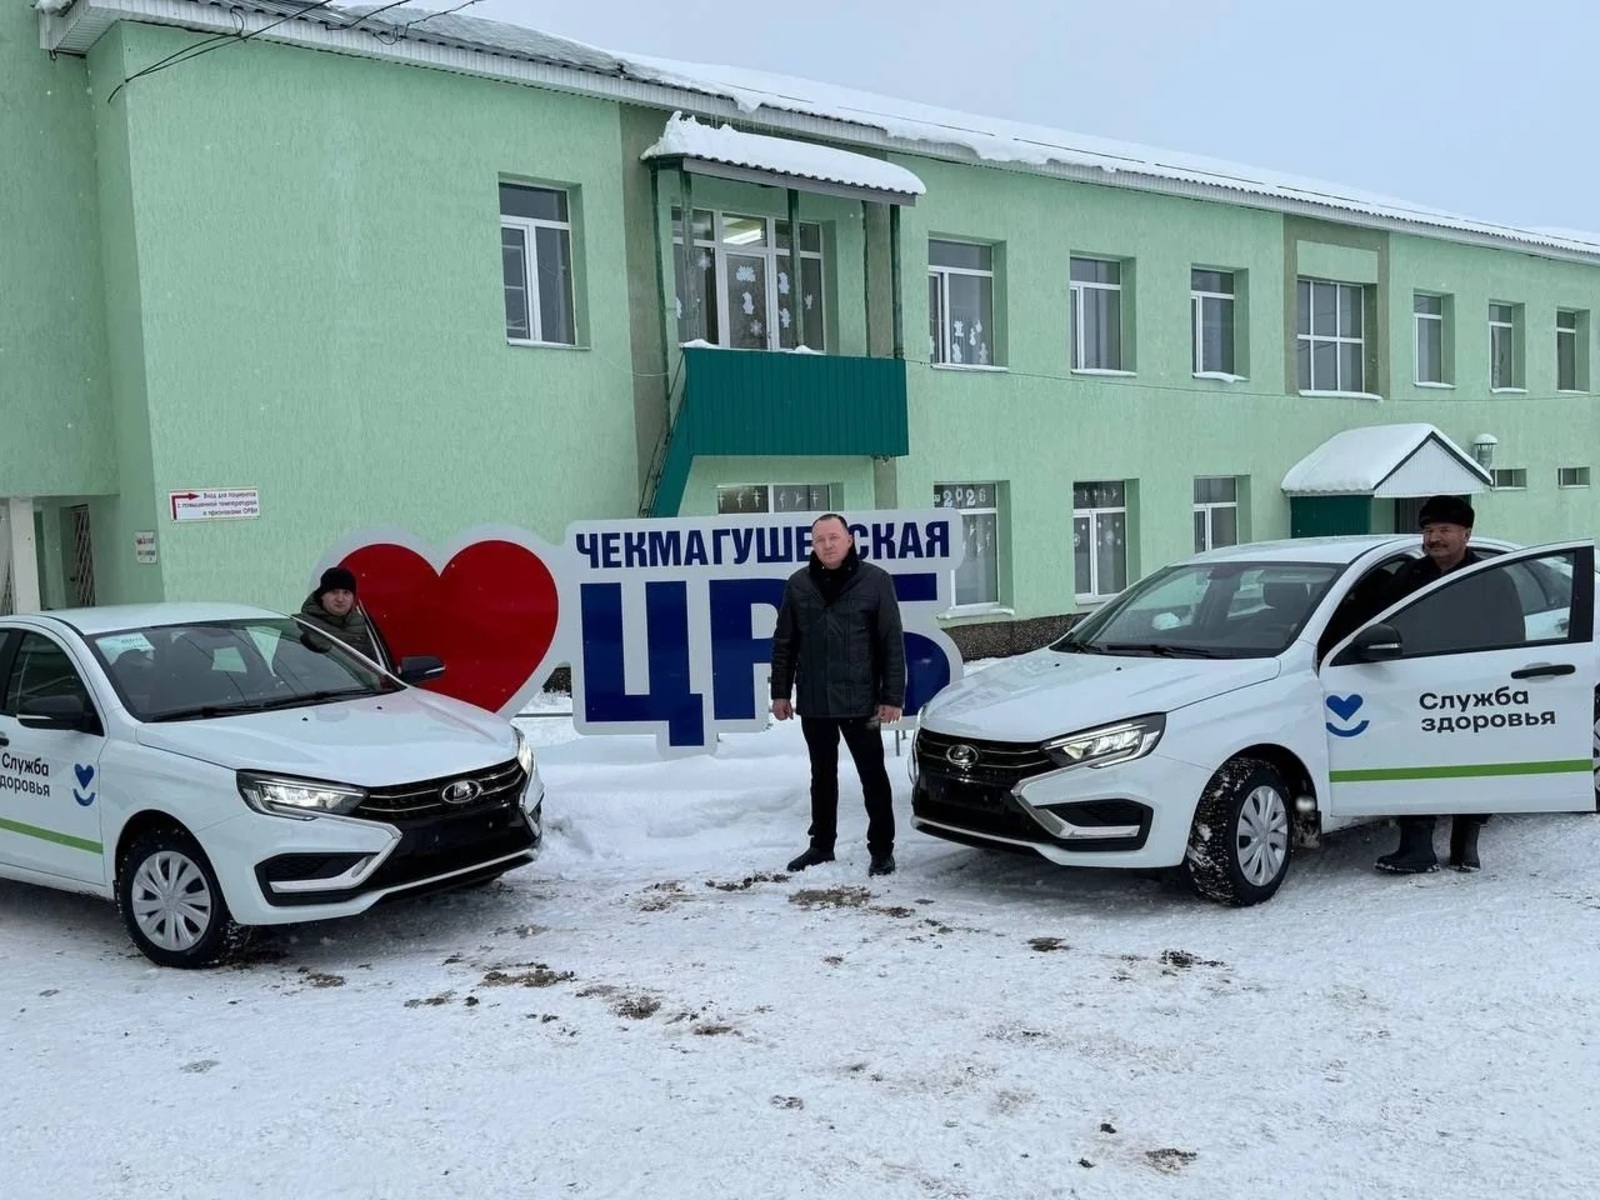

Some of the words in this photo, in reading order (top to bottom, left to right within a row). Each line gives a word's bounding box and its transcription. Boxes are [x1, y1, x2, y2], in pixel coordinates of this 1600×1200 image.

[576, 520, 950, 569] ЧЕКМАГУШЕСКАЯ
[1419, 686, 1529, 712] Служба
[1421, 711, 1556, 733] здоровья
[2, 752, 49, 777] Служба
[0, 774, 50, 797] доровья
